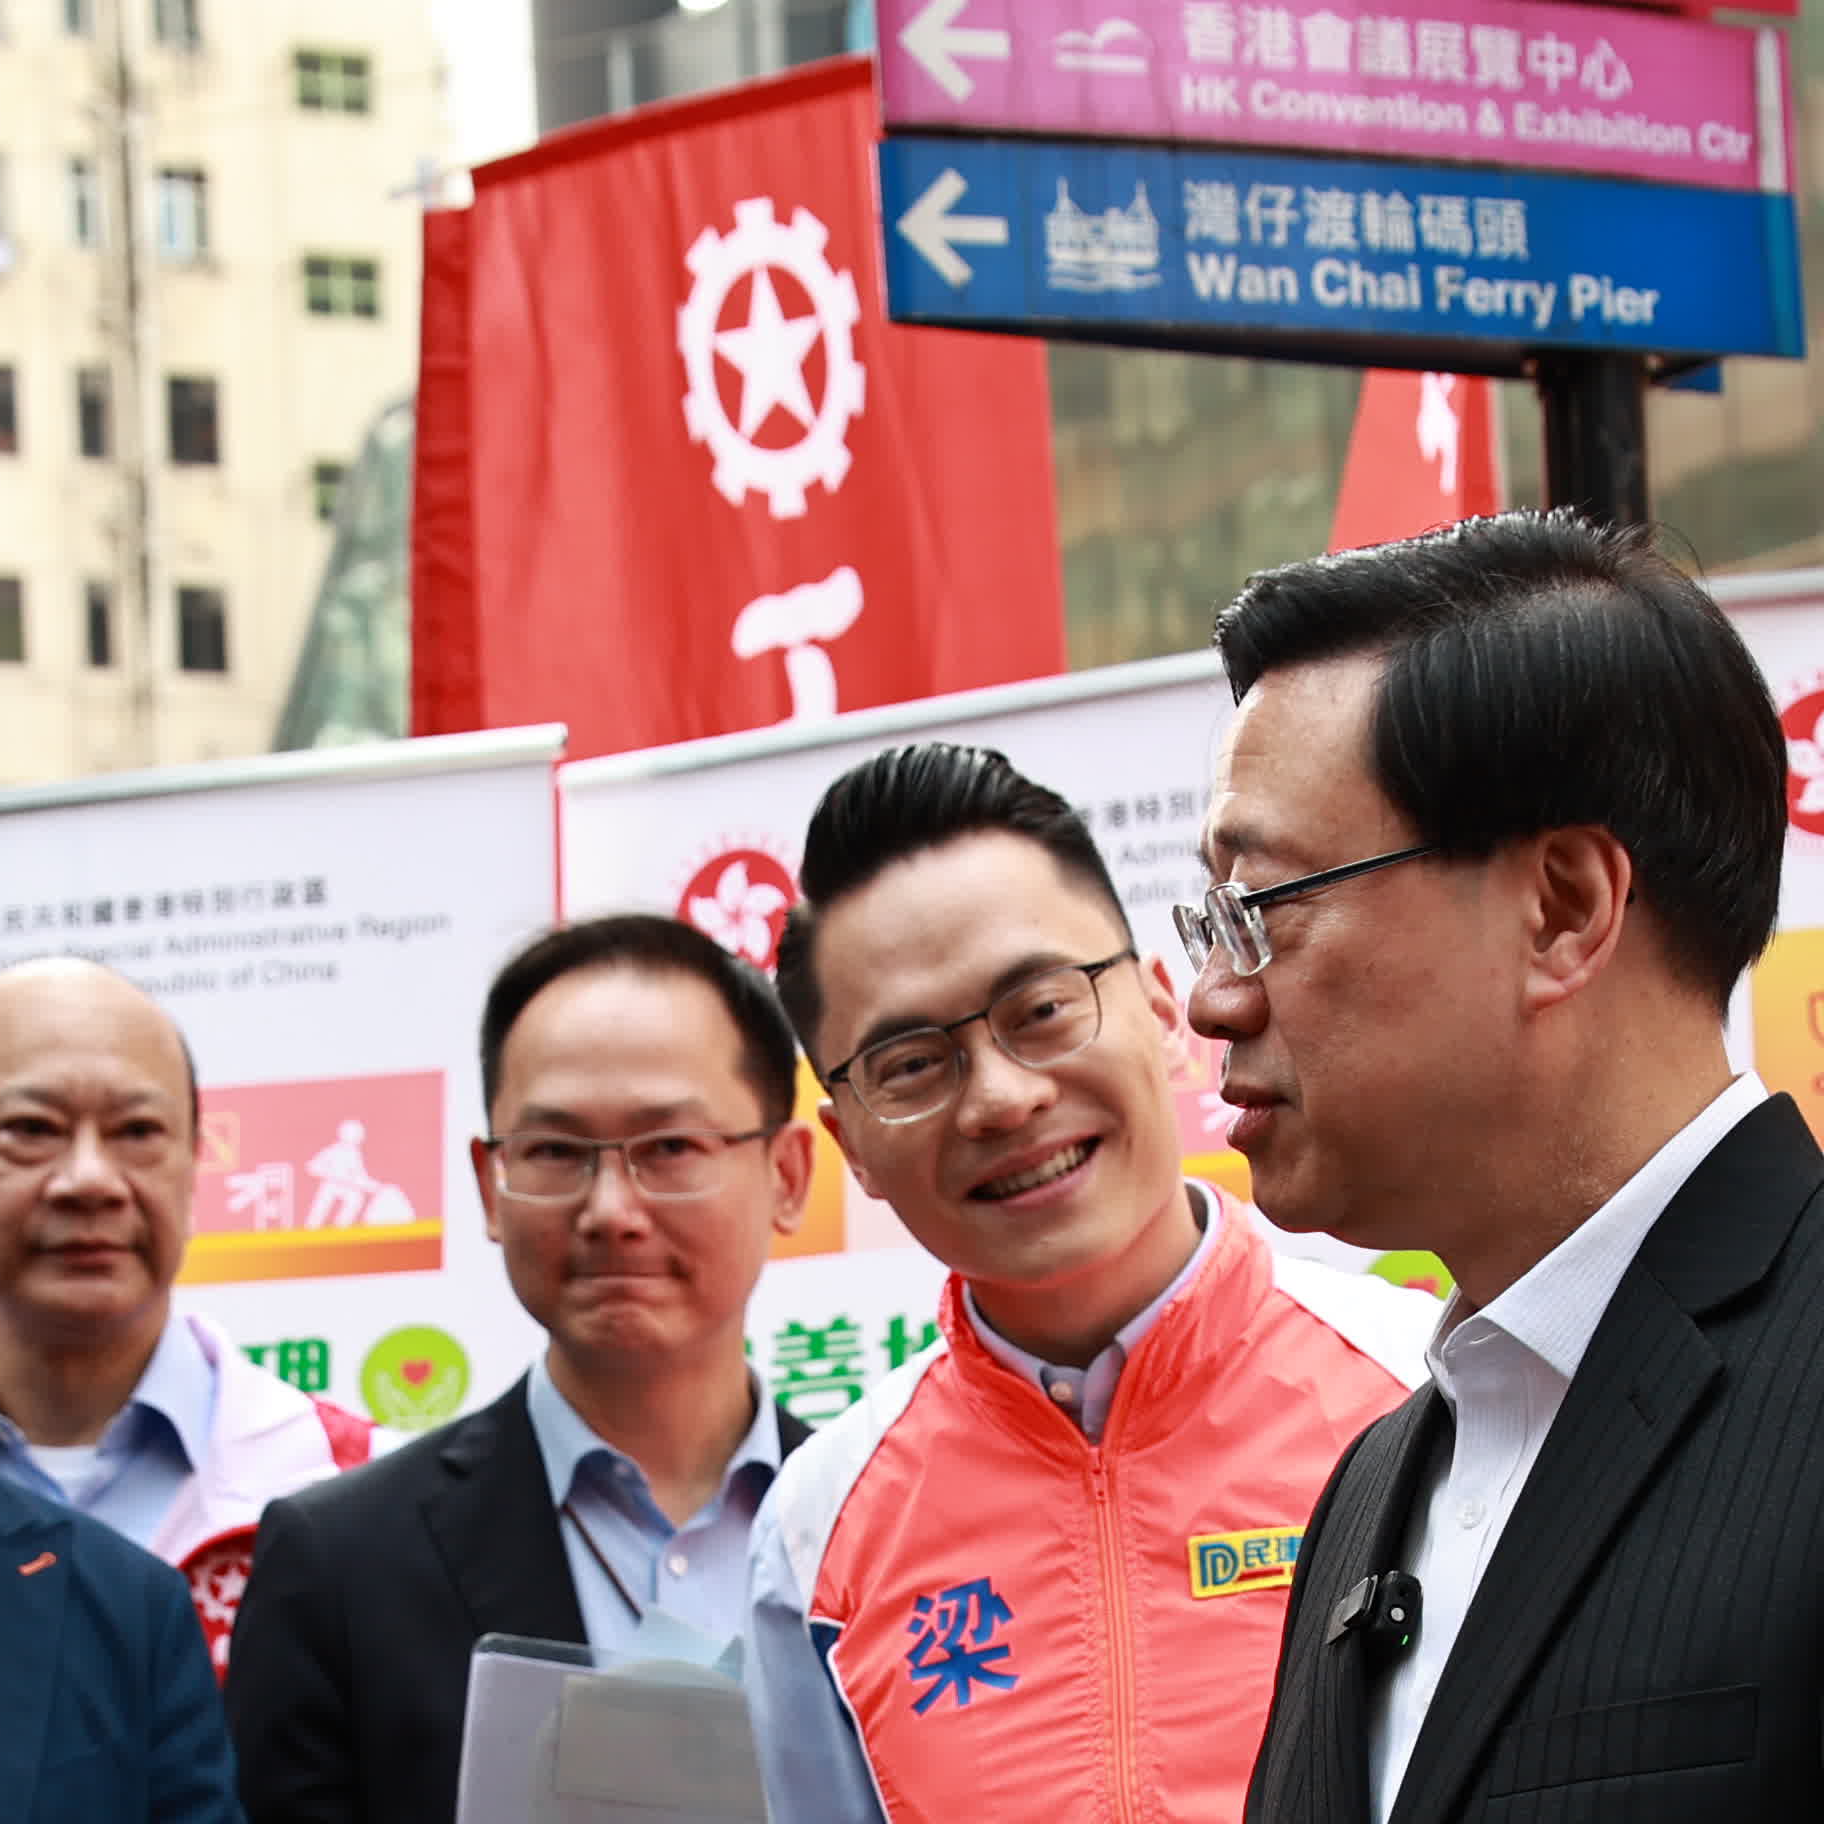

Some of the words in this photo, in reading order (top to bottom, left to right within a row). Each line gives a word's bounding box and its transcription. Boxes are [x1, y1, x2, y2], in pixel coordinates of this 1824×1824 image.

[1184, 2, 1633, 98] 香港會議展覽中心
[1180, 74, 1240, 117] HK
[1251, 79, 1468, 134] Convention
[1476, 97, 1505, 138] &
[1514, 101, 1691, 156] Exhibition
[1698, 120, 1752, 163] Ctr
[1184, 180, 1529, 260] 灣仔渡輪碼頭
[1186, 252, 1299, 303] Wan
[1310, 257, 1422, 311] Chai
[1434, 264, 1557, 330] Ferry
[1569, 272, 1661, 325] Pier
